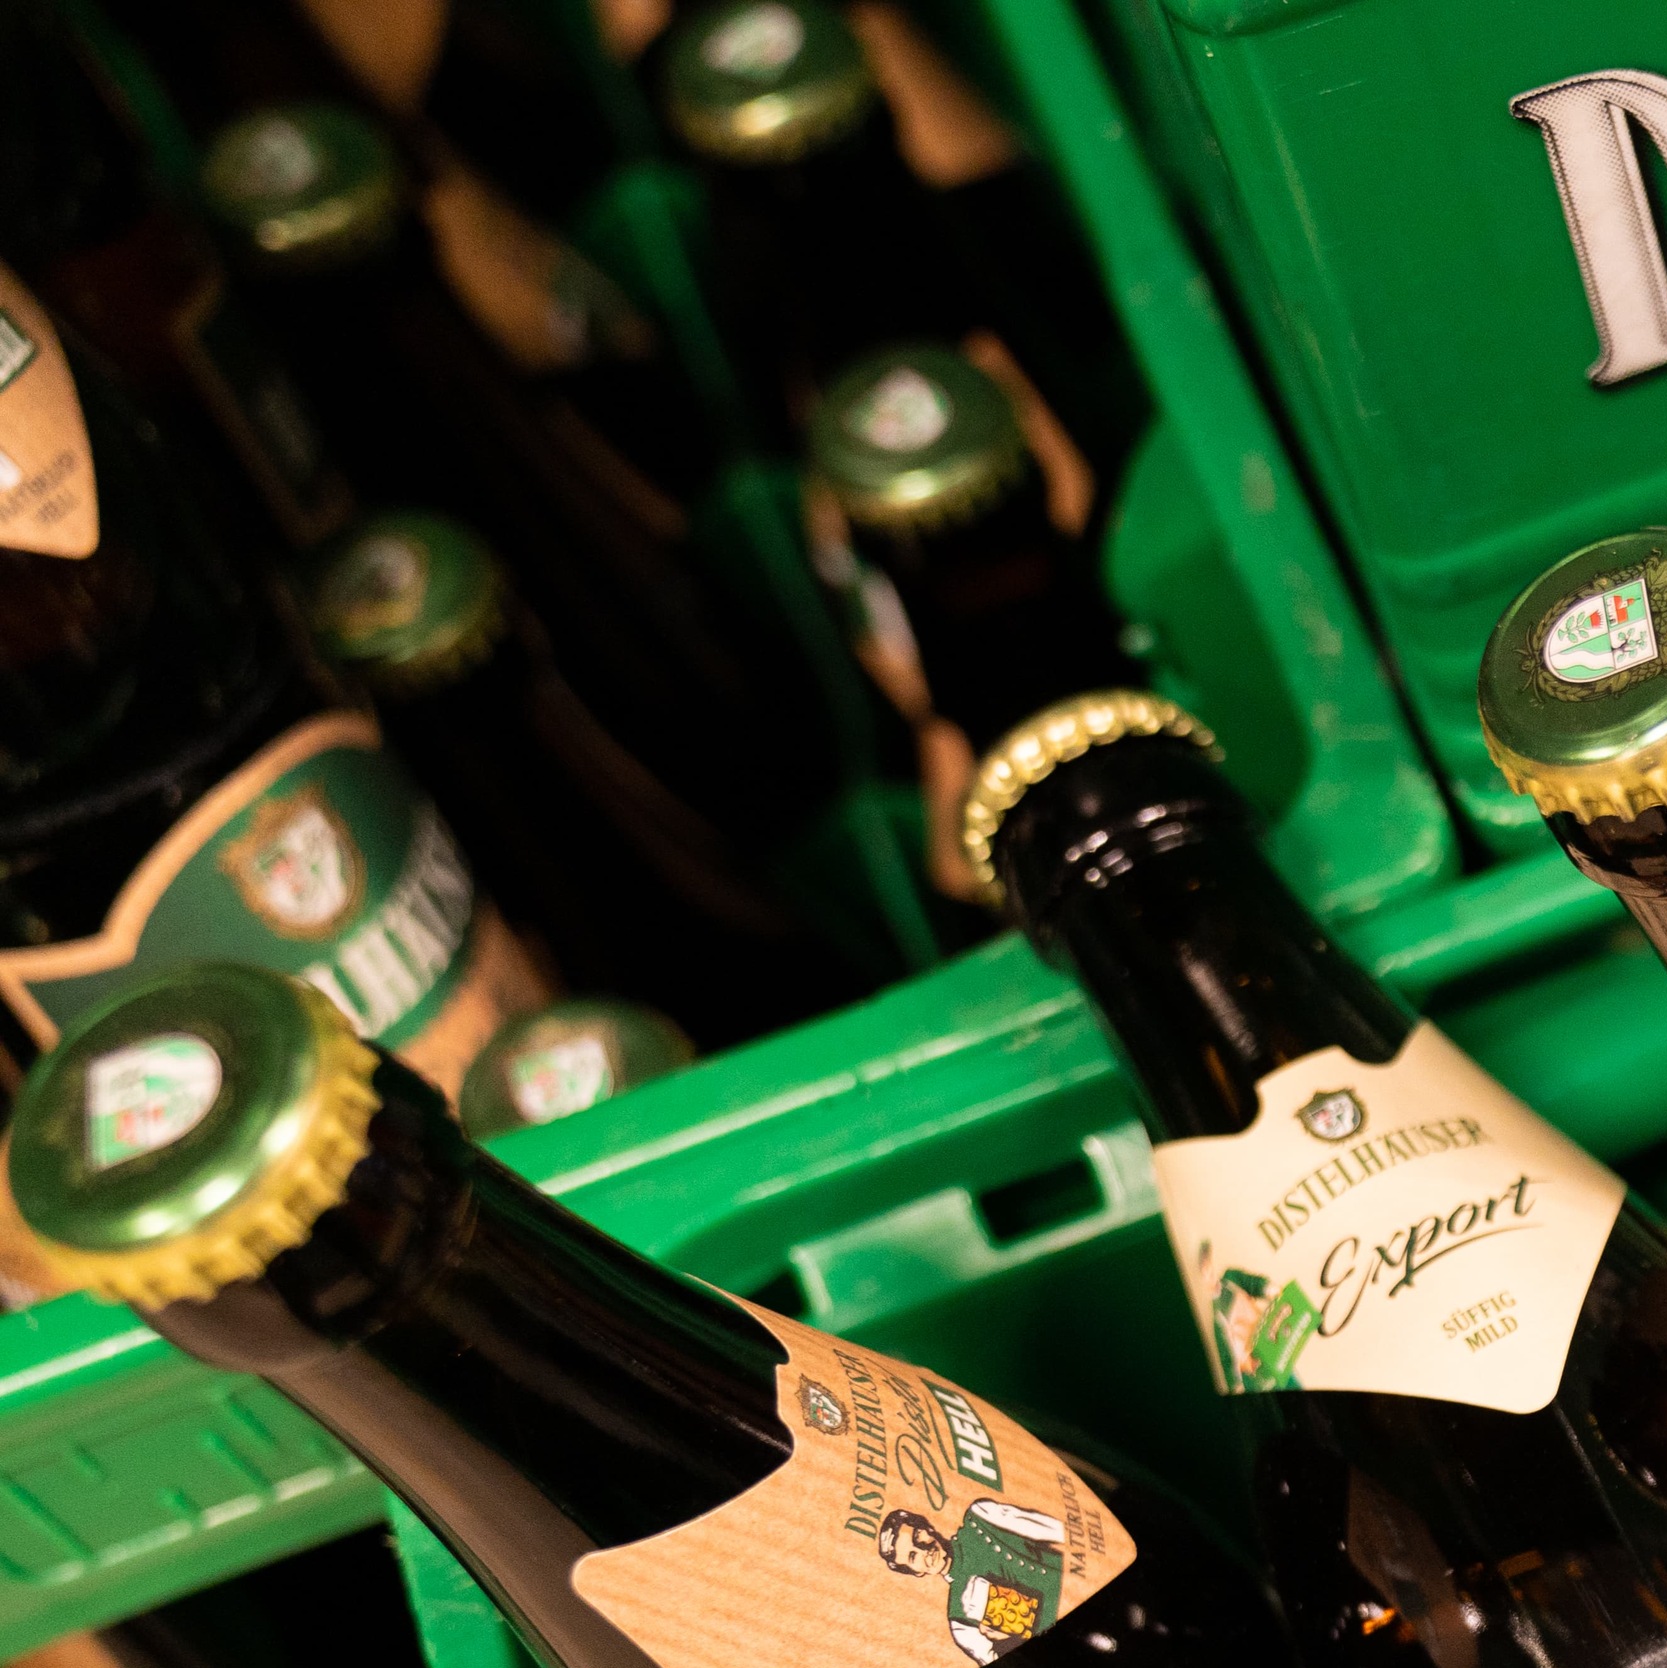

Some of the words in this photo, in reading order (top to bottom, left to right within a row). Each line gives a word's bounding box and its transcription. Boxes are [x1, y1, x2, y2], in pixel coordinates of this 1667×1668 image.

[1256, 1116, 1492, 1254] DISTELHÄUSER
[1318, 1174, 1552, 1338] Export
[1440, 1291, 1518, 1340] SÜFFIG
[1464, 1315, 1519, 1354] MILD
[832, 1348, 888, 1541] DISTELHÄUSER
[935, 1388, 998, 1482] HELL
[1058, 1472, 1087, 1579] NATÜRLICH
[1088, 1510, 1109, 1557] HELL
